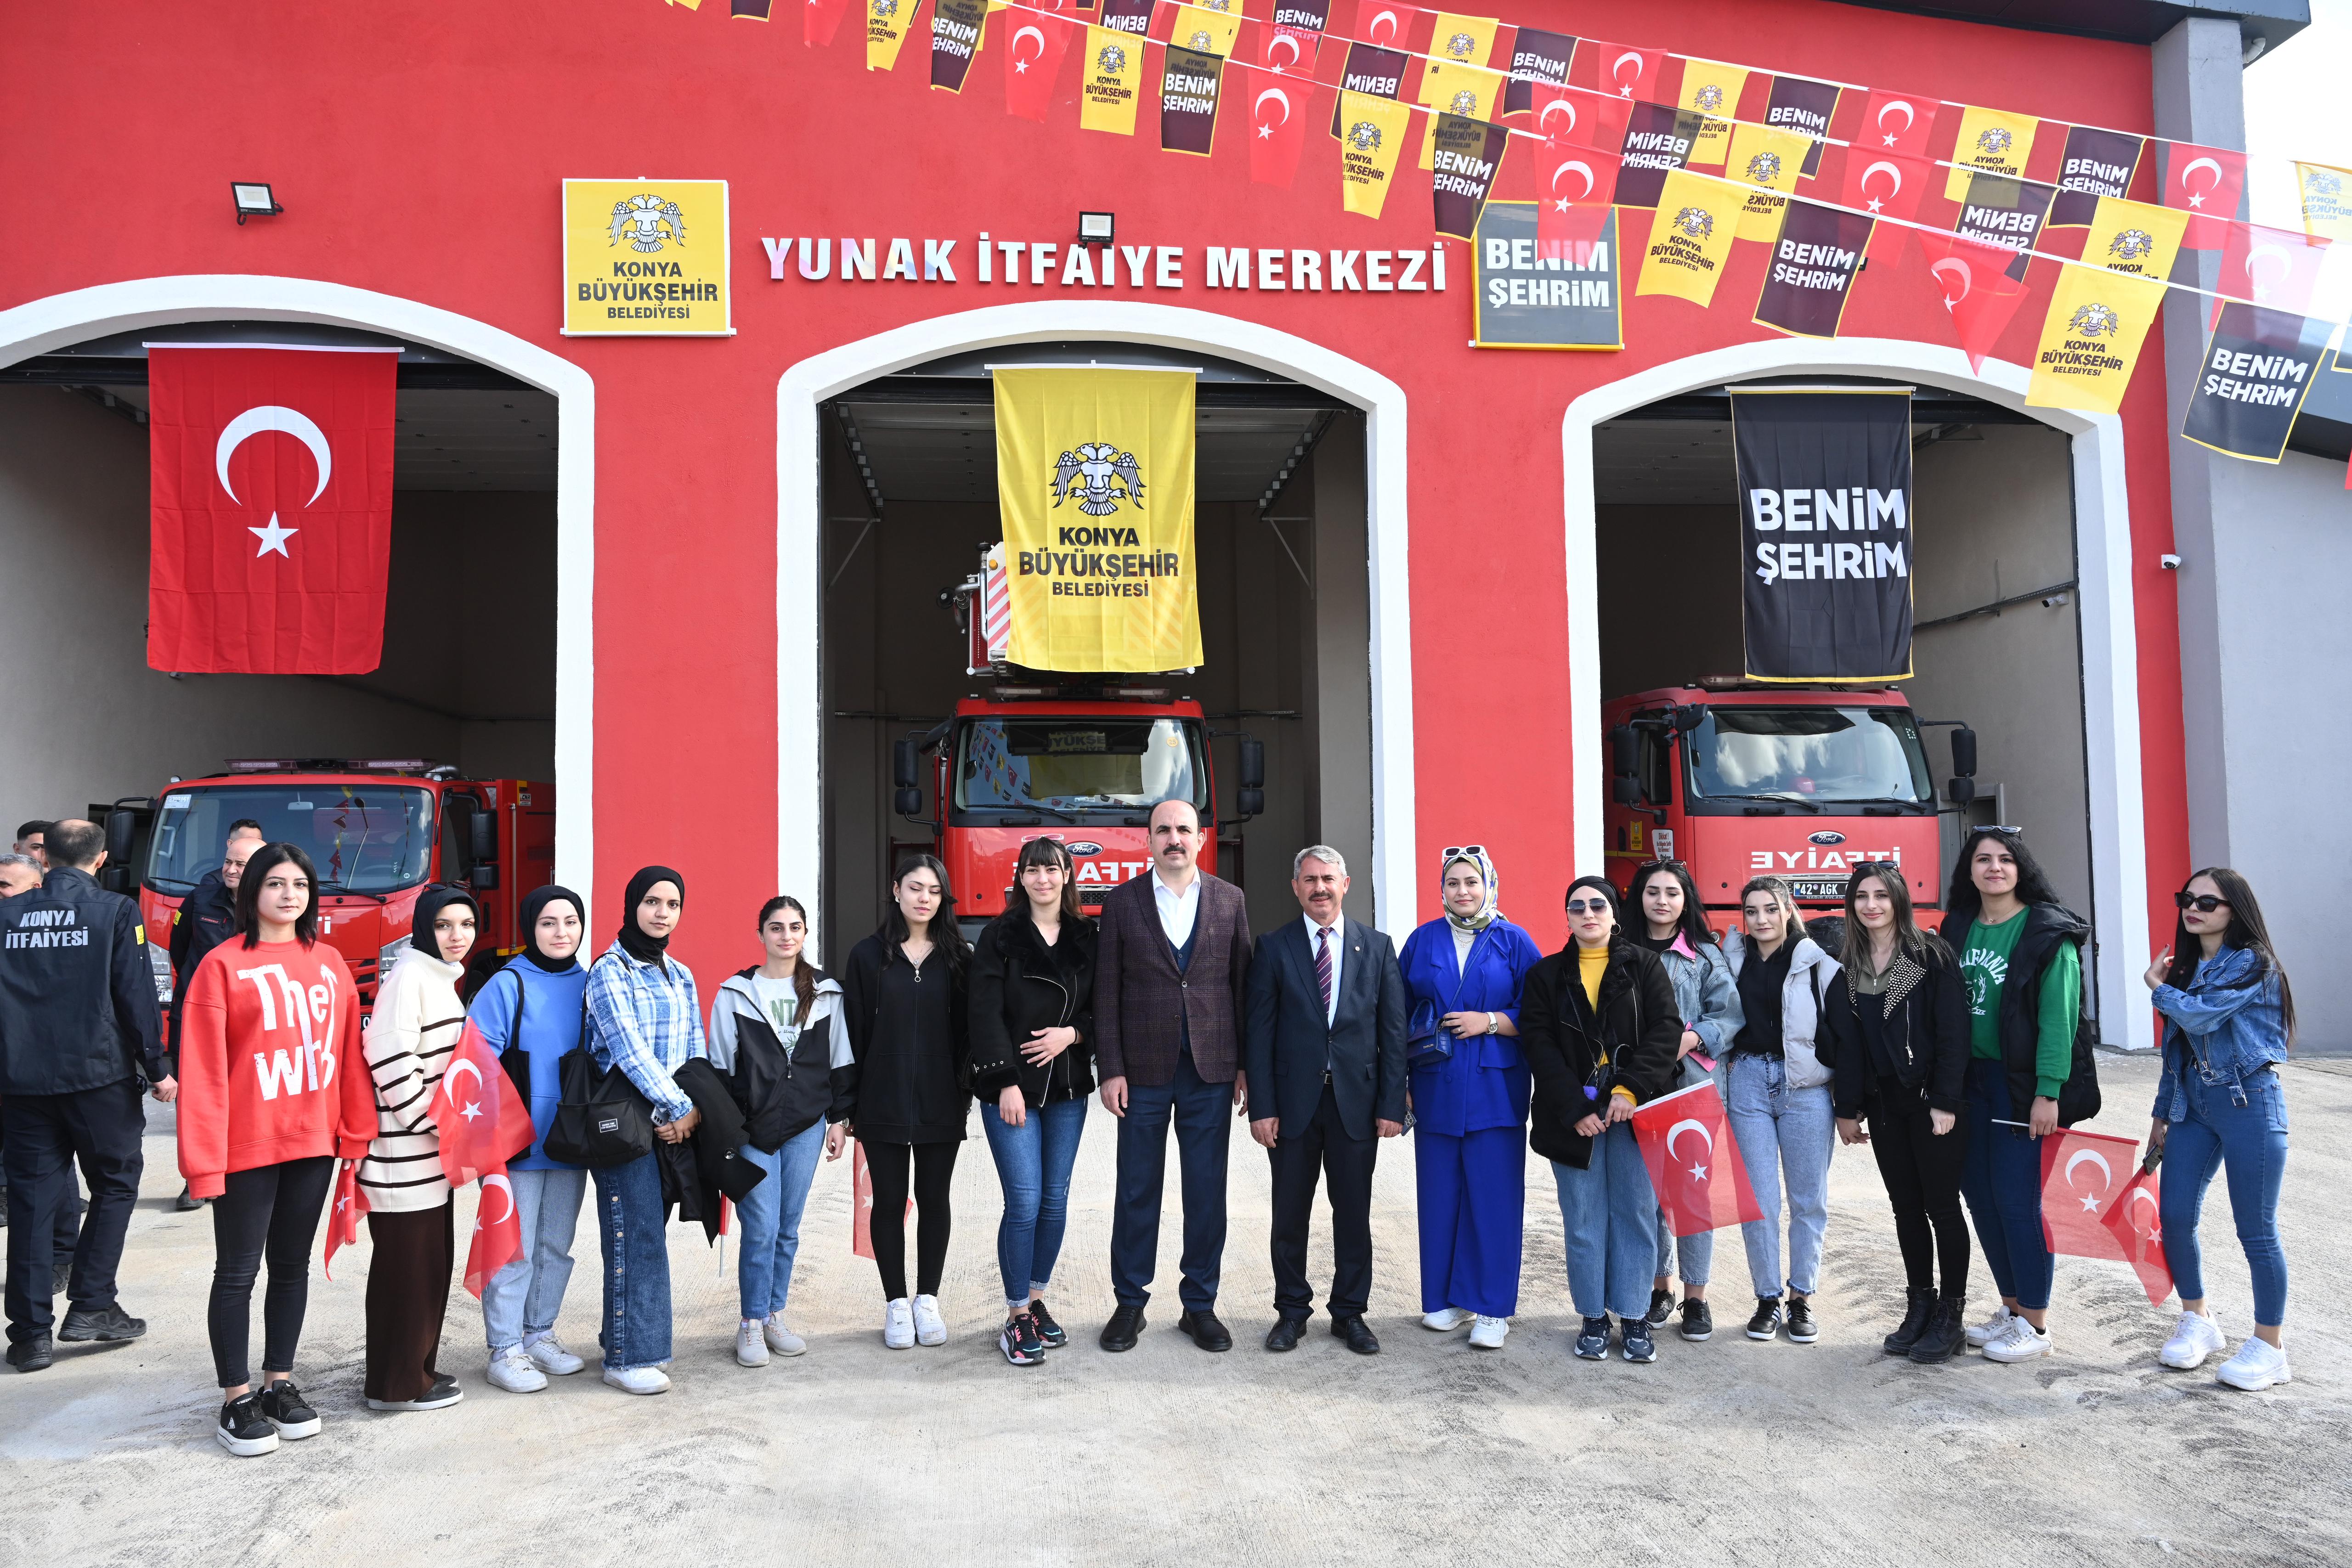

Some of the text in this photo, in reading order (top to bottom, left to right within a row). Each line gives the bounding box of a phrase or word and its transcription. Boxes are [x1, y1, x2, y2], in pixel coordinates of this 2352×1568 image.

[870, 18, 888, 28] KONYA
[1097, 76, 1120, 86] KONYA
[1086, 83, 1131, 99] BÜYÜKŞEHİR
[1092, 96, 1119, 105] BELEDİYESİ
[1345, 152, 1372, 165] KONYA
[1669, 235, 1702, 253] KONYA
[761, 237, 957, 282] YUNAK
[1207, 242, 1446, 292] MERKEZİ
[1651, 243, 1714, 271] BÜYÜKŞEHİR
[1659, 257, 1699, 272] BELEDİYESİ
[613, 261, 682, 277] KONYA
[578, 278, 718, 306] BÜYÜKŞEHİR
[607, 305, 690, 319] BELEDİYESİ
[2064, 340, 2106, 353] KONYA
[2041, 350, 2123, 371] BÜYÜKŞEHİR
[2052, 366, 2102, 377] BELEDİYESİ
[1059, 527, 1140, 547] KONYA
[1019, 547, 1178, 581] BÜYÜKŞEHİR
[1052, 580, 1148, 597] BELEDİYESİ
[1817, 834, 1837, 843] Ford
[1073, 844, 1093, 853] Ford
[1800, 884, 1812, 895] 42
[1820, 884, 1838, 895] AGK
[20, 910, 75, 927] KONYA
[6, 926, 88, 948] İTFAİYESİ
[237, 964, 329, 1031] The
